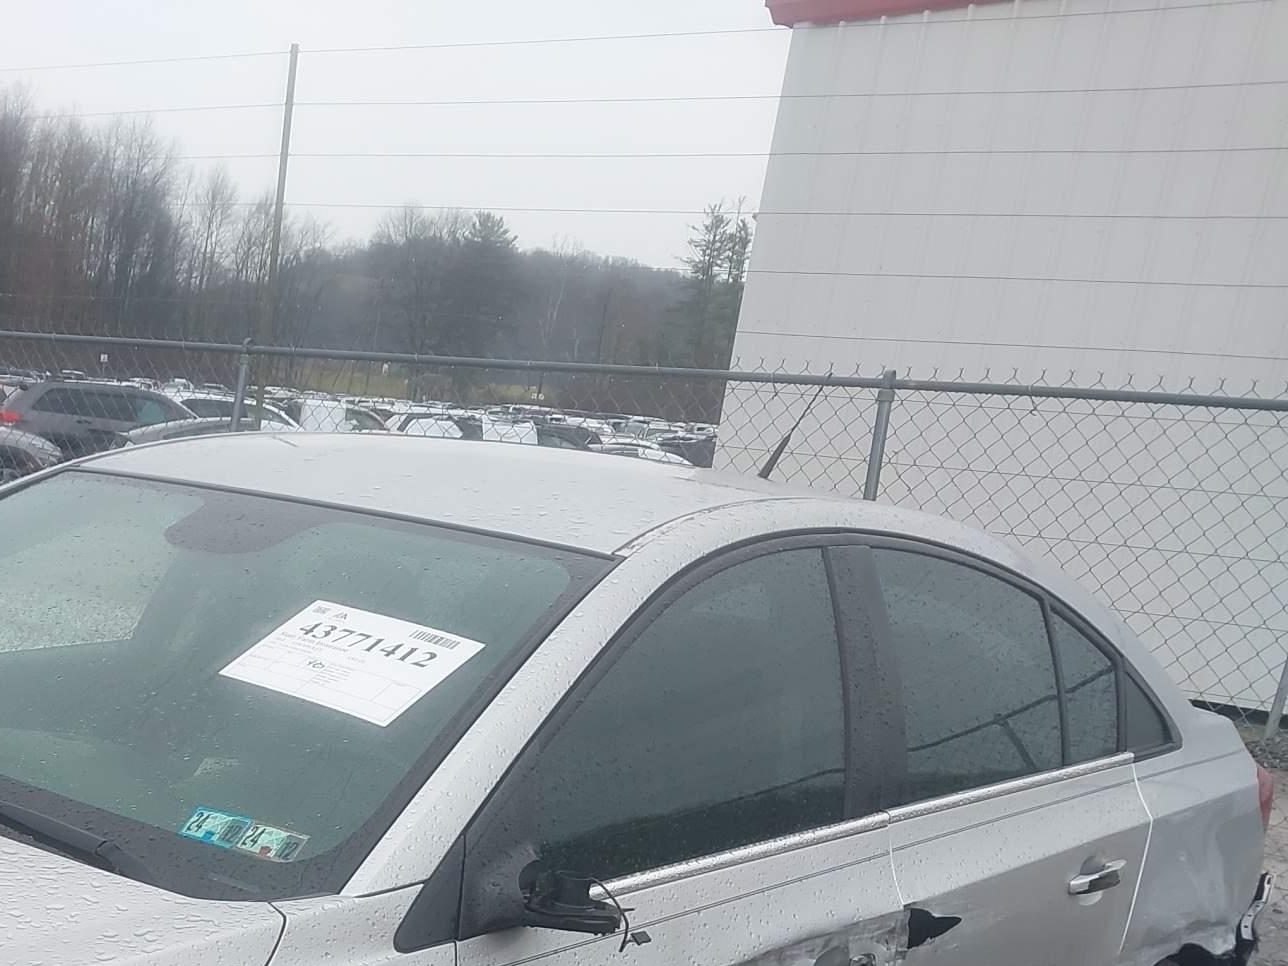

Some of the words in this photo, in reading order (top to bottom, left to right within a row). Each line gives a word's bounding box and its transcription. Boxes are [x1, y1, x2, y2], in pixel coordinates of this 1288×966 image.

[299, 622, 438, 668] 43771412
[186, 811, 213, 833] 24
[241, 826, 267, 848] 24
